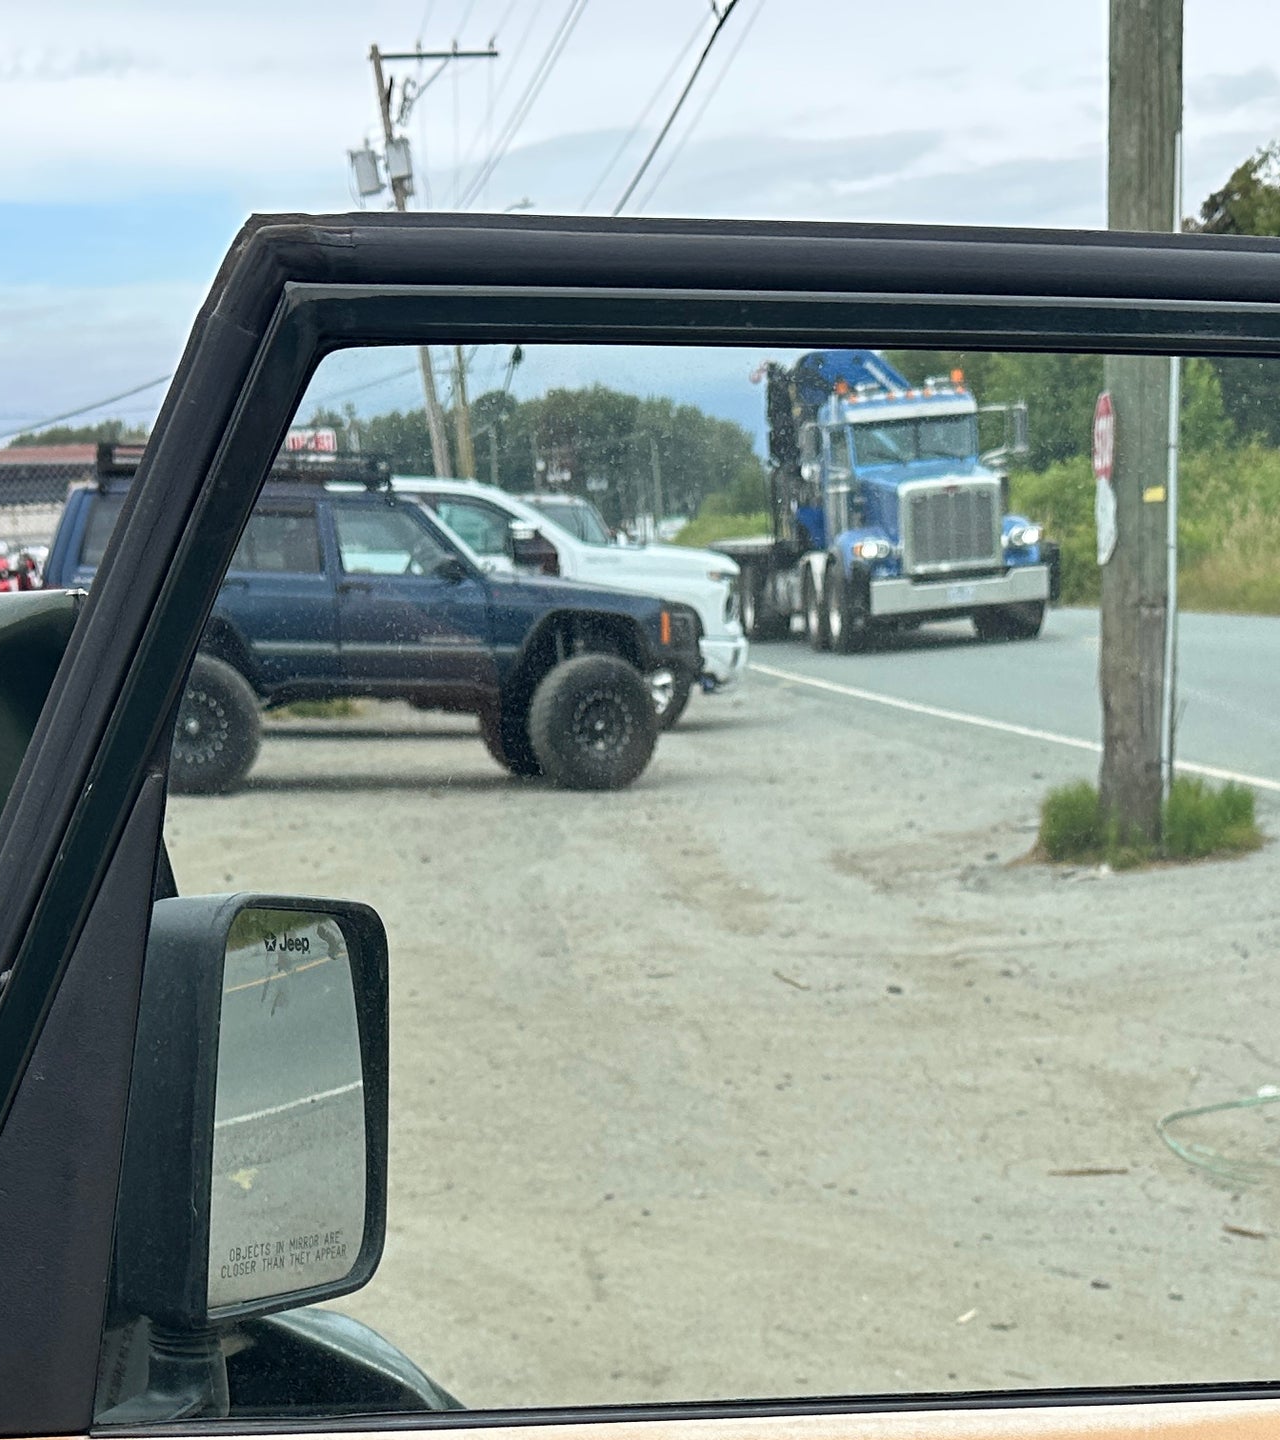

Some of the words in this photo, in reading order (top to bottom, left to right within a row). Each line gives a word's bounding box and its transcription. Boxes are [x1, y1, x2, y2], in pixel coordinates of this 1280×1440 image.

[279, 932, 310, 955] Jeep
[221, 1259, 257, 1279] CLOSER
[262, 1255, 285, 1272] THAN
[290, 1250, 311, 1267] THEY
[315, 1243, 347, 1261] APPEAR
[229, 1242, 271, 1263] OBJECTS
[276, 1240, 285, 1254] IN
[289, 1233, 320, 1251] MIRROR
[324, 1230, 340, 1245] ARE
